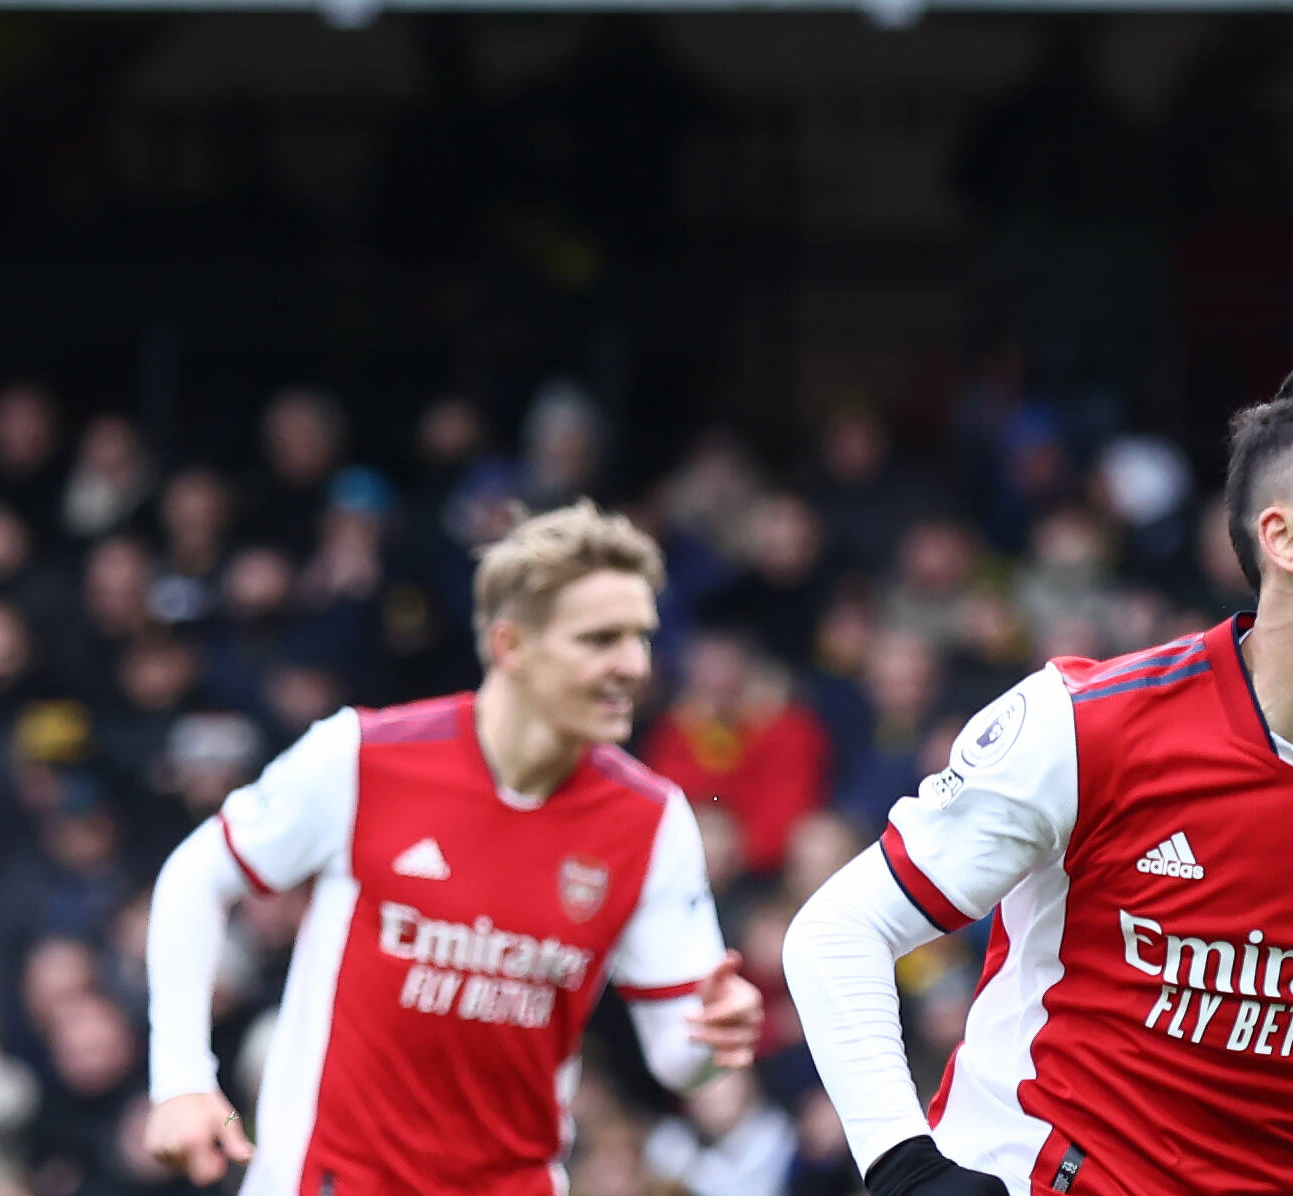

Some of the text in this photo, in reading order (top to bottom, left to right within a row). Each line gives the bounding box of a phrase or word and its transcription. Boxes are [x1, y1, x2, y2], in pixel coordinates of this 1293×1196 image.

[1136, 857, 1205, 880] adidas
[379, 900, 594, 992] Emirates
[1144, 984, 1224, 1043] FLY
